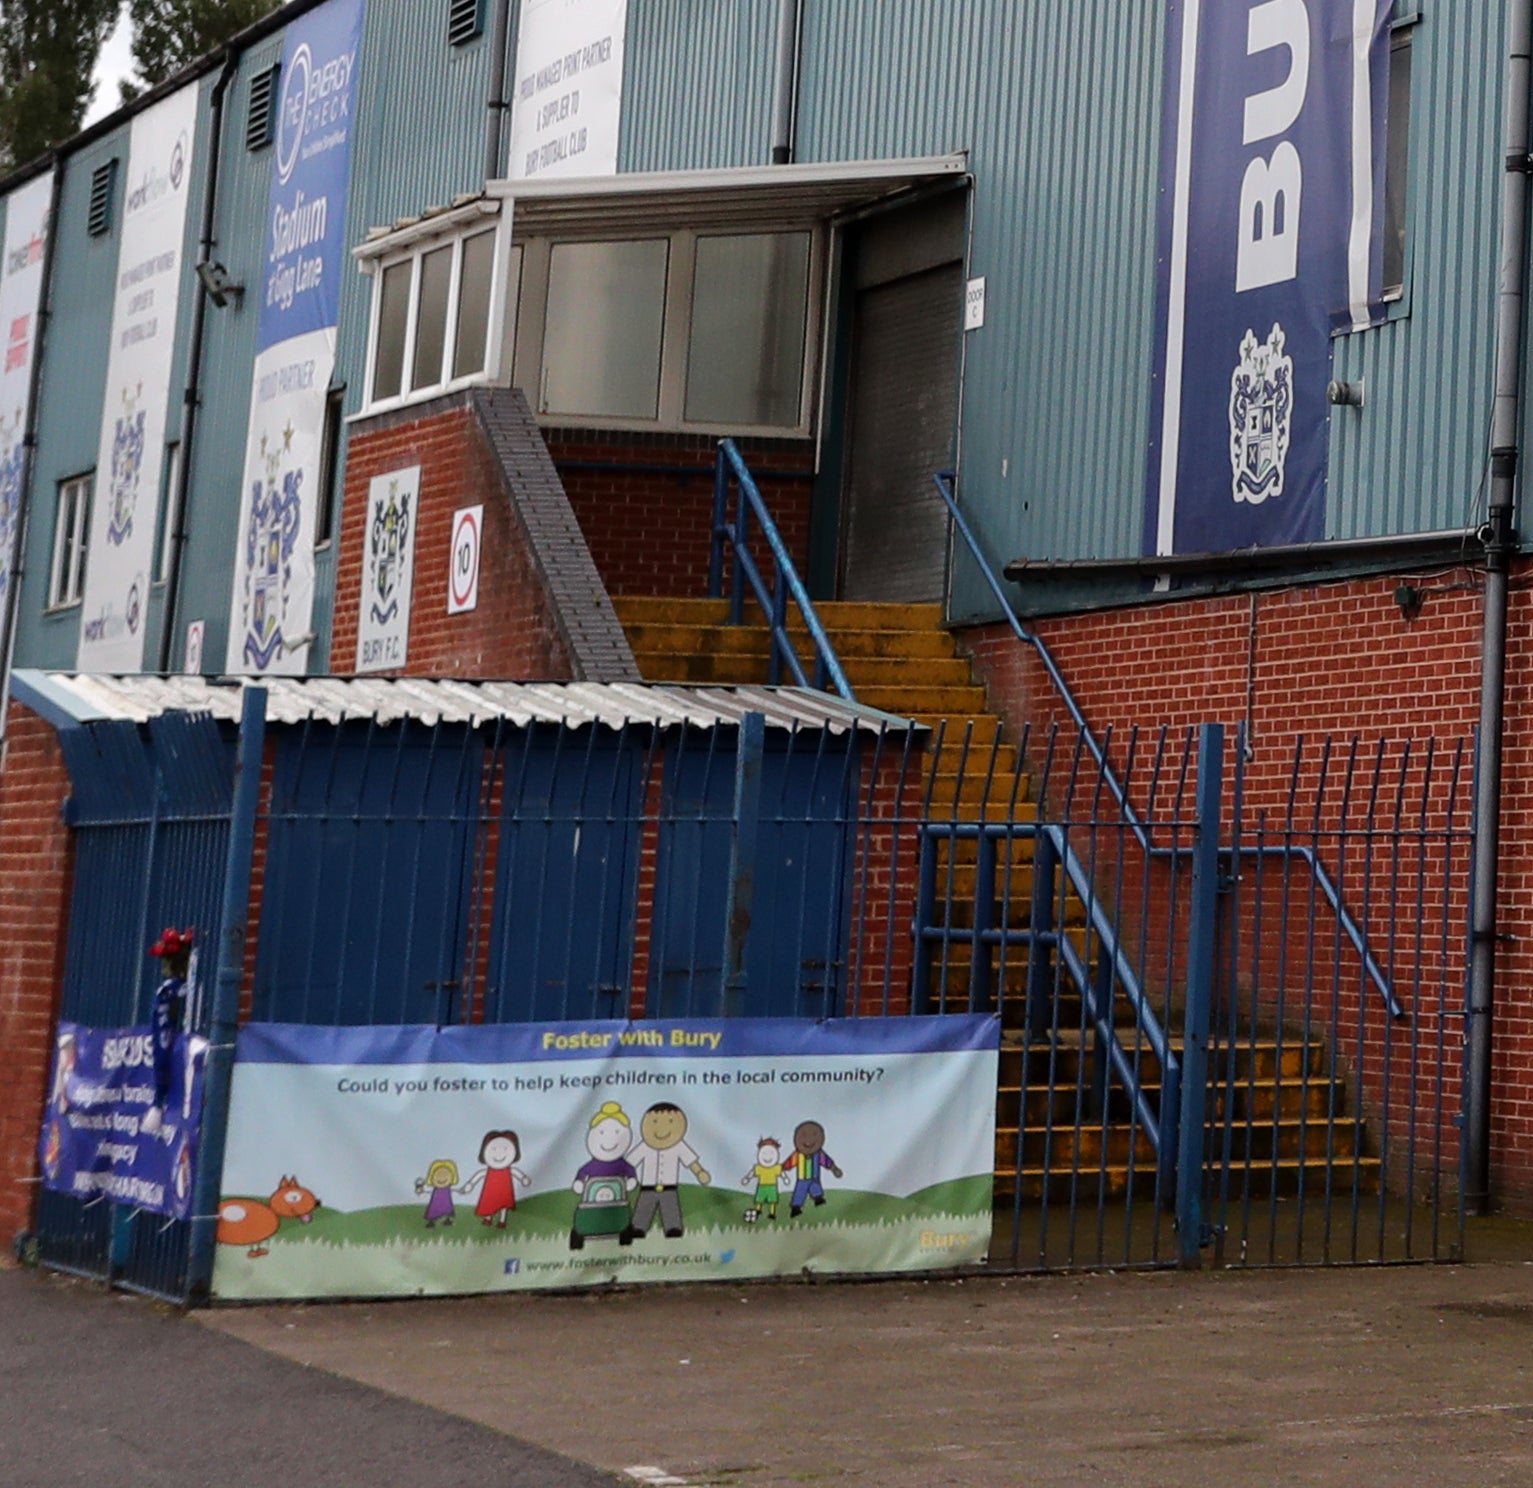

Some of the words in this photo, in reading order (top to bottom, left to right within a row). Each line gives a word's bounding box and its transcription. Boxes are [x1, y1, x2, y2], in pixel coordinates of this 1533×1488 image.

[562, 48, 582, 81] PRINT
[581, 36, 613, 71] PARTNER
[304, 93, 349, 136] CHECK
[542, 94, 570, 130] SUPPLIER
[570, 89, 580, 116] TO
[539, 134, 569, 169] FOOTBALL
[568, 127, 588, 157] CLUB
[270, 190, 328, 262] Stadium
[296, 254, 323, 294] Lane
[457, 542, 471, 578] 10
[363, 638, 383, 665] BURY
[542, 1032, 612, 1051] Foster
[618, 1029, 664, 1047] with
[670, 1029, 722, 1050] Bury
[337, 1077, 389, 1094] Could
[395, 1079, 428, 1096] you
[433, 1076, 488, 1092] foster
[492, 1078, 509, 1092] to
[514, 1075, 554, 1093] help
[560, 1074, 602, 1091] keep
[605, 1070, 677, 1086] children
[682, 1070, 697, 1085] in
[703, 1070, 731, 1085] the
[736, 1069, 776, 1084] local
[780, 1068, 885, 1086] community?
[526, 1252, 712, 1272] www.fosterwithbury.co.uk
